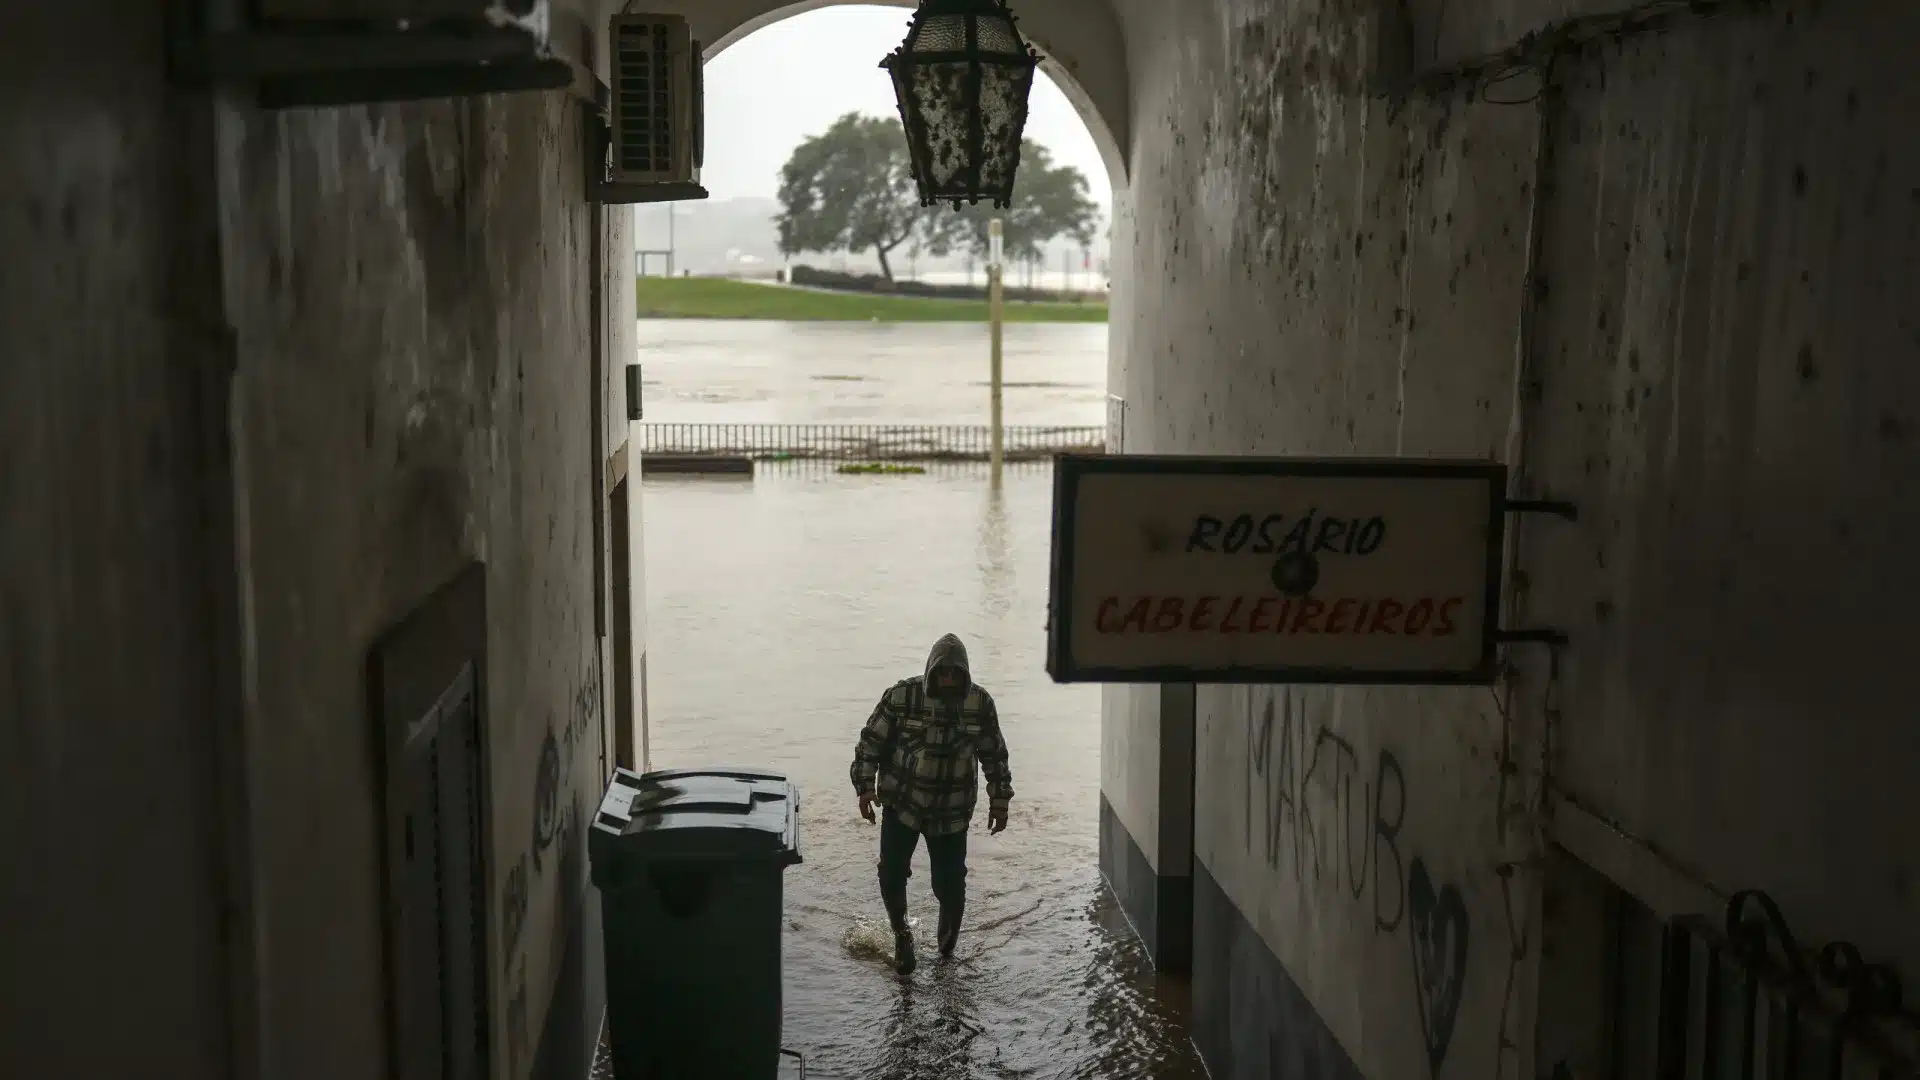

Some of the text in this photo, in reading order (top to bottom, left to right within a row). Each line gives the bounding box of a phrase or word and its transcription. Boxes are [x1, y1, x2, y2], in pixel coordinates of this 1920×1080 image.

[1186, 507, 1387, 554] ROSÁRIO
[1096, 596, 1464, 635] CABELEIREIROS
[1246, 686, 1405, 935] MAKTUB
